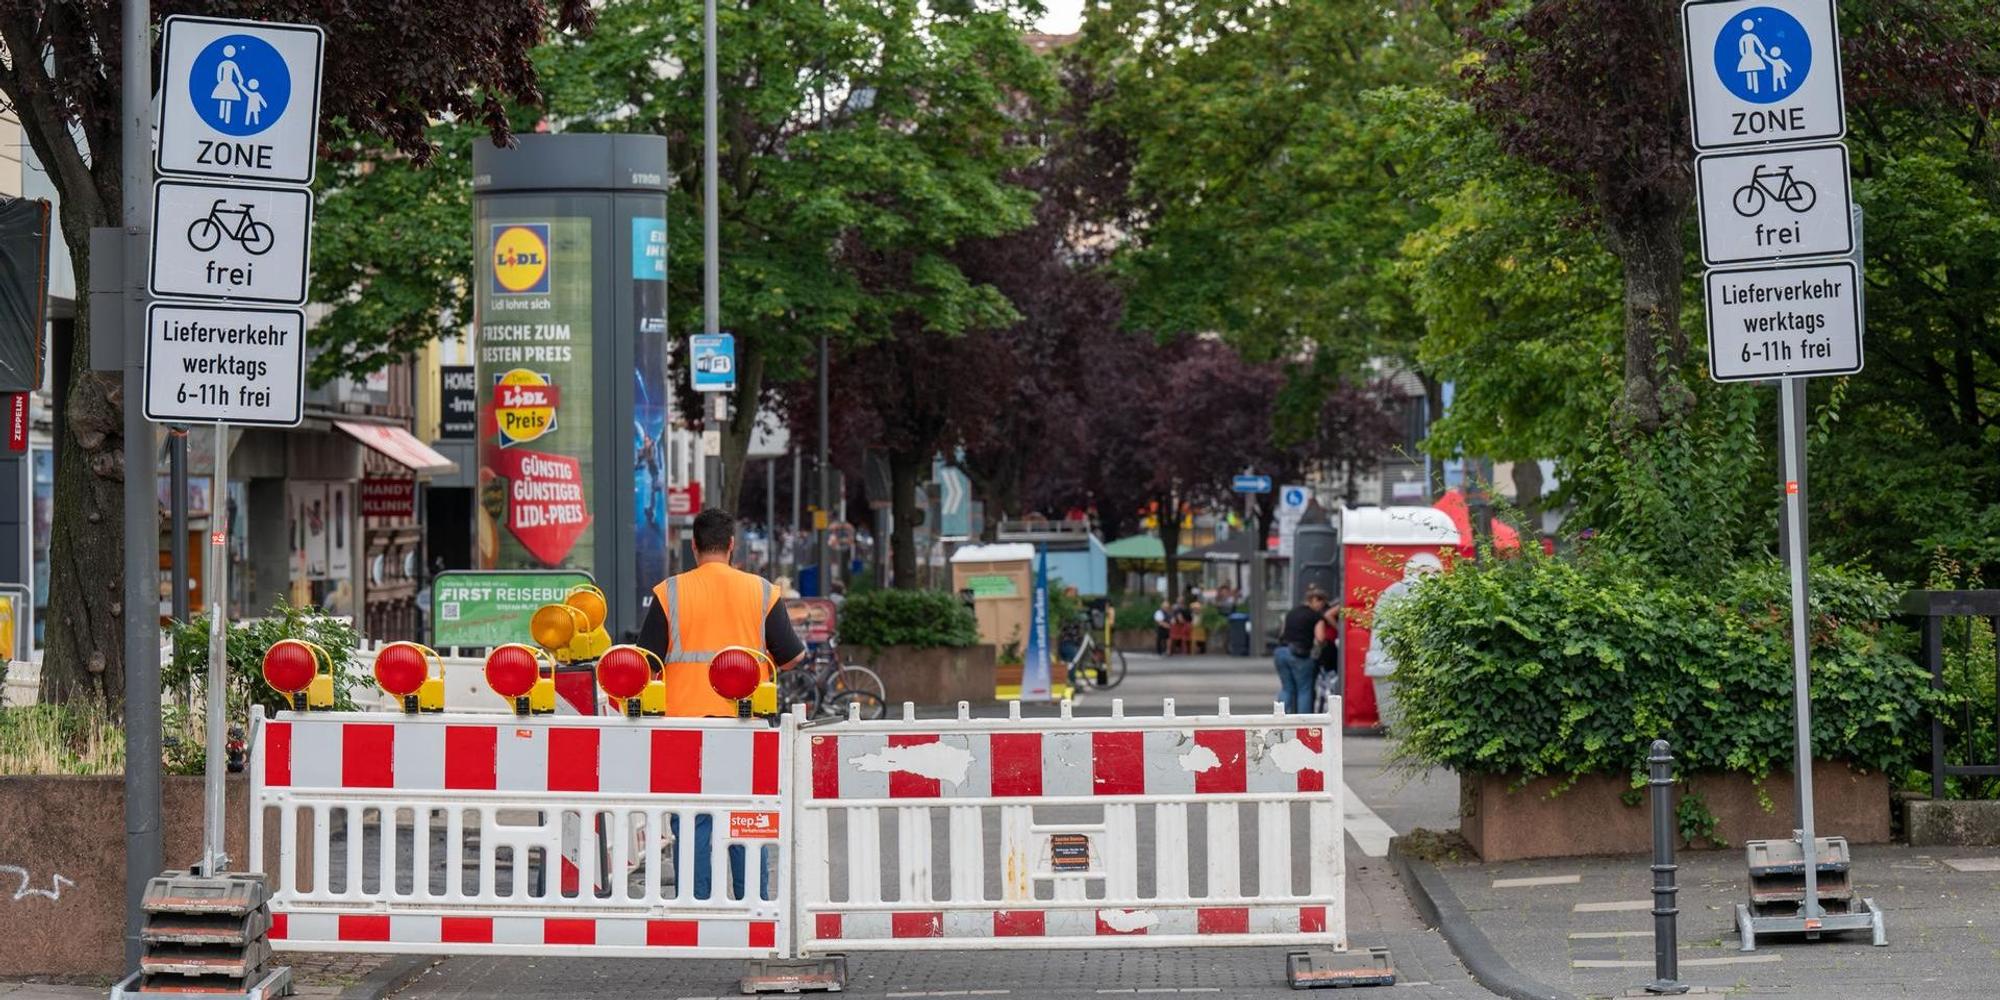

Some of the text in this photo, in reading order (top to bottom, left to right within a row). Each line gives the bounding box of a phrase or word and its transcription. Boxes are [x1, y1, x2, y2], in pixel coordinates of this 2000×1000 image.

[1732, 107, 1806, 136] ZONE
[197, 140, 273, 169] ZONE
[1755, 221, 1800, 246] frei
[206, 261, 252, 286] frei
[505, 299, 529, 310] lohnt
[530, 298, 550, 310] sich
[1722, 279, 1841, 305] Lieferverkehr
[163, 320, 288, 346] Lieferverkehr
[483, 324, 570, 341] FRISCHE ZUM
[1743, 312, 1825, 334] werktags
[483, 346, 571, 362] BESTEN PREIS
[1741, 338, 1831, 363] 6-11h frei
[183, 354, 267, 381] werktags
[177, 383, 270, 407] 6-11h frei
[15, 395, 23, 441] ZEPPELIN
[506, 411, 544, 430] Preis
[521, 455, 572, 480] GÜNSTIG
[363, 485, 413, 495] HANDY
[514, 476, 581, 501] GÜNSTIGER
[363, 500, 413, 511] KLINIK
[516, 503, 583, 528] LIDL-PREIS
[439, 587, 492, 600] FIRST
[731, 816, 754, 828] step
